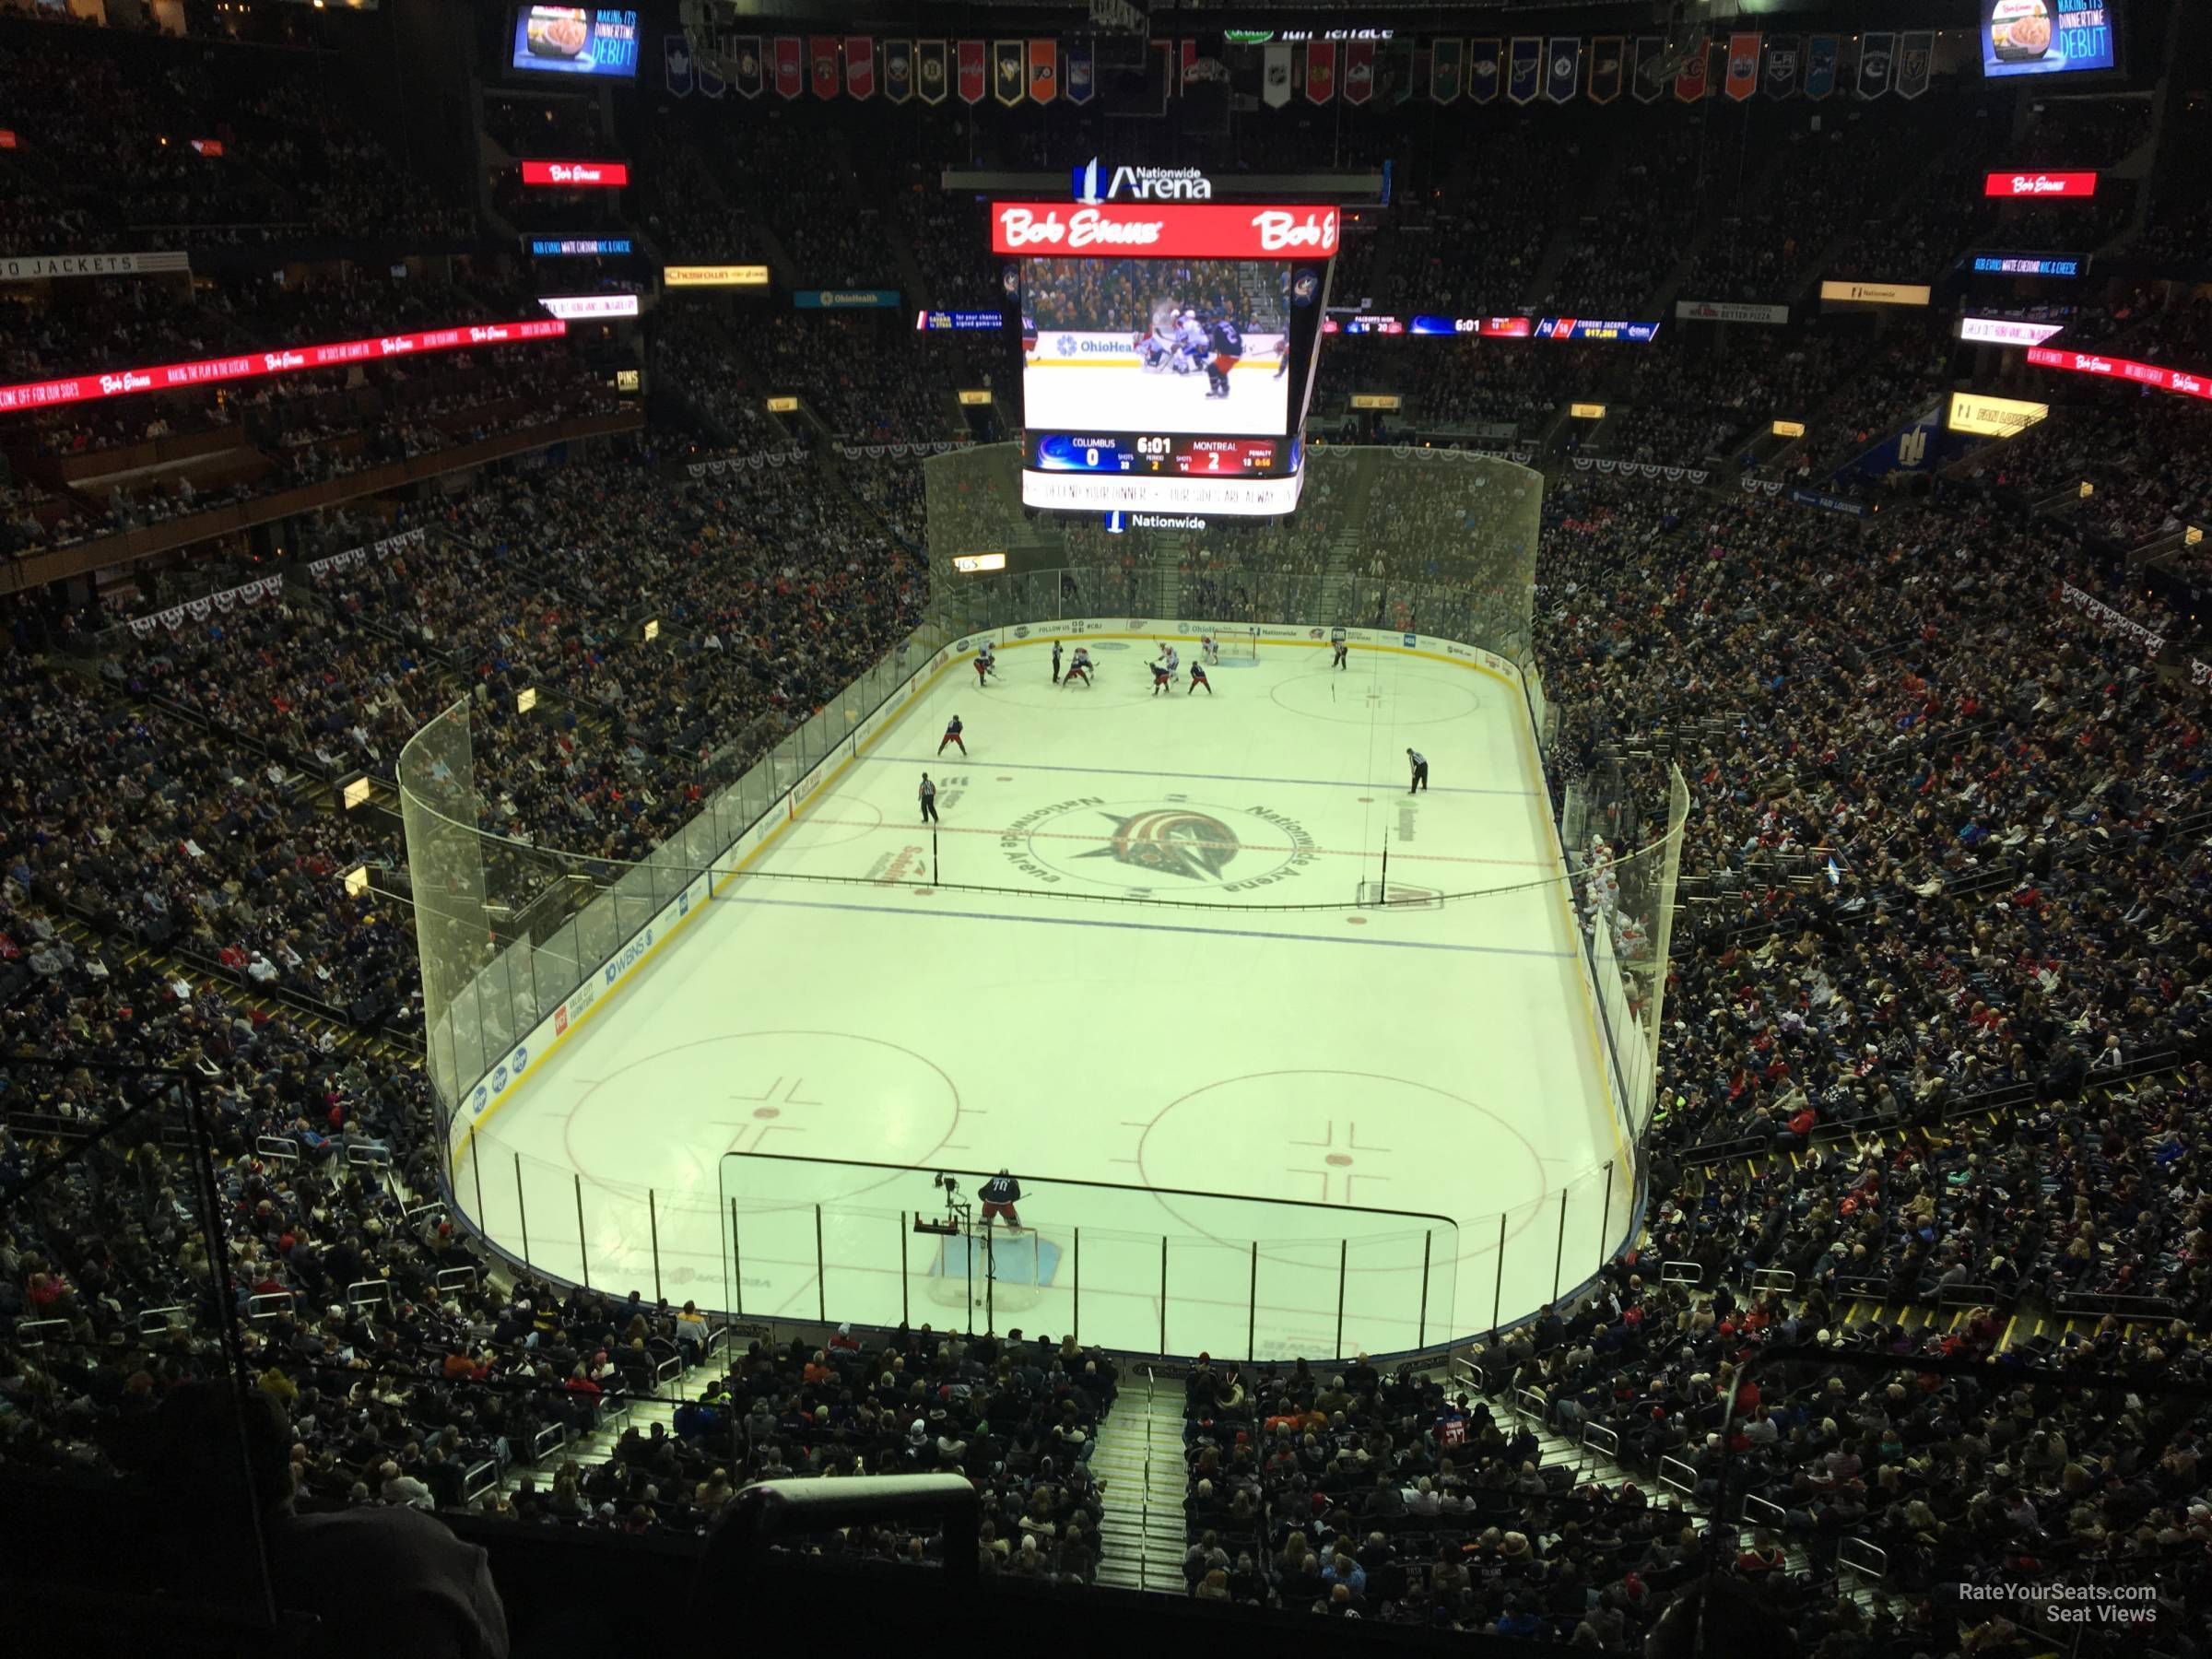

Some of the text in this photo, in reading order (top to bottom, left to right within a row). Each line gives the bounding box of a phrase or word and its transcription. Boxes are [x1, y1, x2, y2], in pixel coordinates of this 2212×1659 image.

[624, 11, 636, 25] ITS
[2059, 10, 2104, 29] DINNERTIME
[595, 22, 634, 39] DINNERTIME
[592, 38, 634, 65] DEBUT
[2059, 27, 2107, 59] DEBUT
[549, 165, 571, 182] Bob
[1136, 167, 1201, 179] Nationwide
[1108, 167, 1211, 198] Arena
[2012, 176, 2033, 194] Bob
[1000, 208, 1159, 248] Bob Evans
[1252, 210, 1322, 250] Bob
[34, 256, 131, 275] JACKETS
[1455, 319, 1479, 332] 6:01
[1578, 320, 1628, 330] CURRENT JACKPOT
[1750, 312, 1771, 321] PIZZA
[1378, 324, 1387, 332] 20
[265, 354, 282, 371] Bob
[100, 372, 150, 394] Bob Evans
[618, 370, 639, 385] PINS
[18, 389, 31, 404] OFF
[32, 387, 45, 402] FOR
[46, 384, 60, 399] OUR
[61, 382, 79, 398] SIDES
[1073, 436, 1237, 453] COLUMBUS 6:01 MONTREAL
[1087, 448, 1099, 466] 0
[1152, 462, 1159, 470] 2
[1208, 453, 1219, 470] 2
[1132, 513, 1206, 530] Nationwide
[1263, 629, 1297, 637] Nationwide
[1001, 796, 1106, 848] Nationwide
[1245, 805, 1322, 866] Nationwide
[1005, 850, 1061, 883] Arena
[1223, 866, 1300, 893] Arena
[605, 936, 644, 985] 10 WBNS
